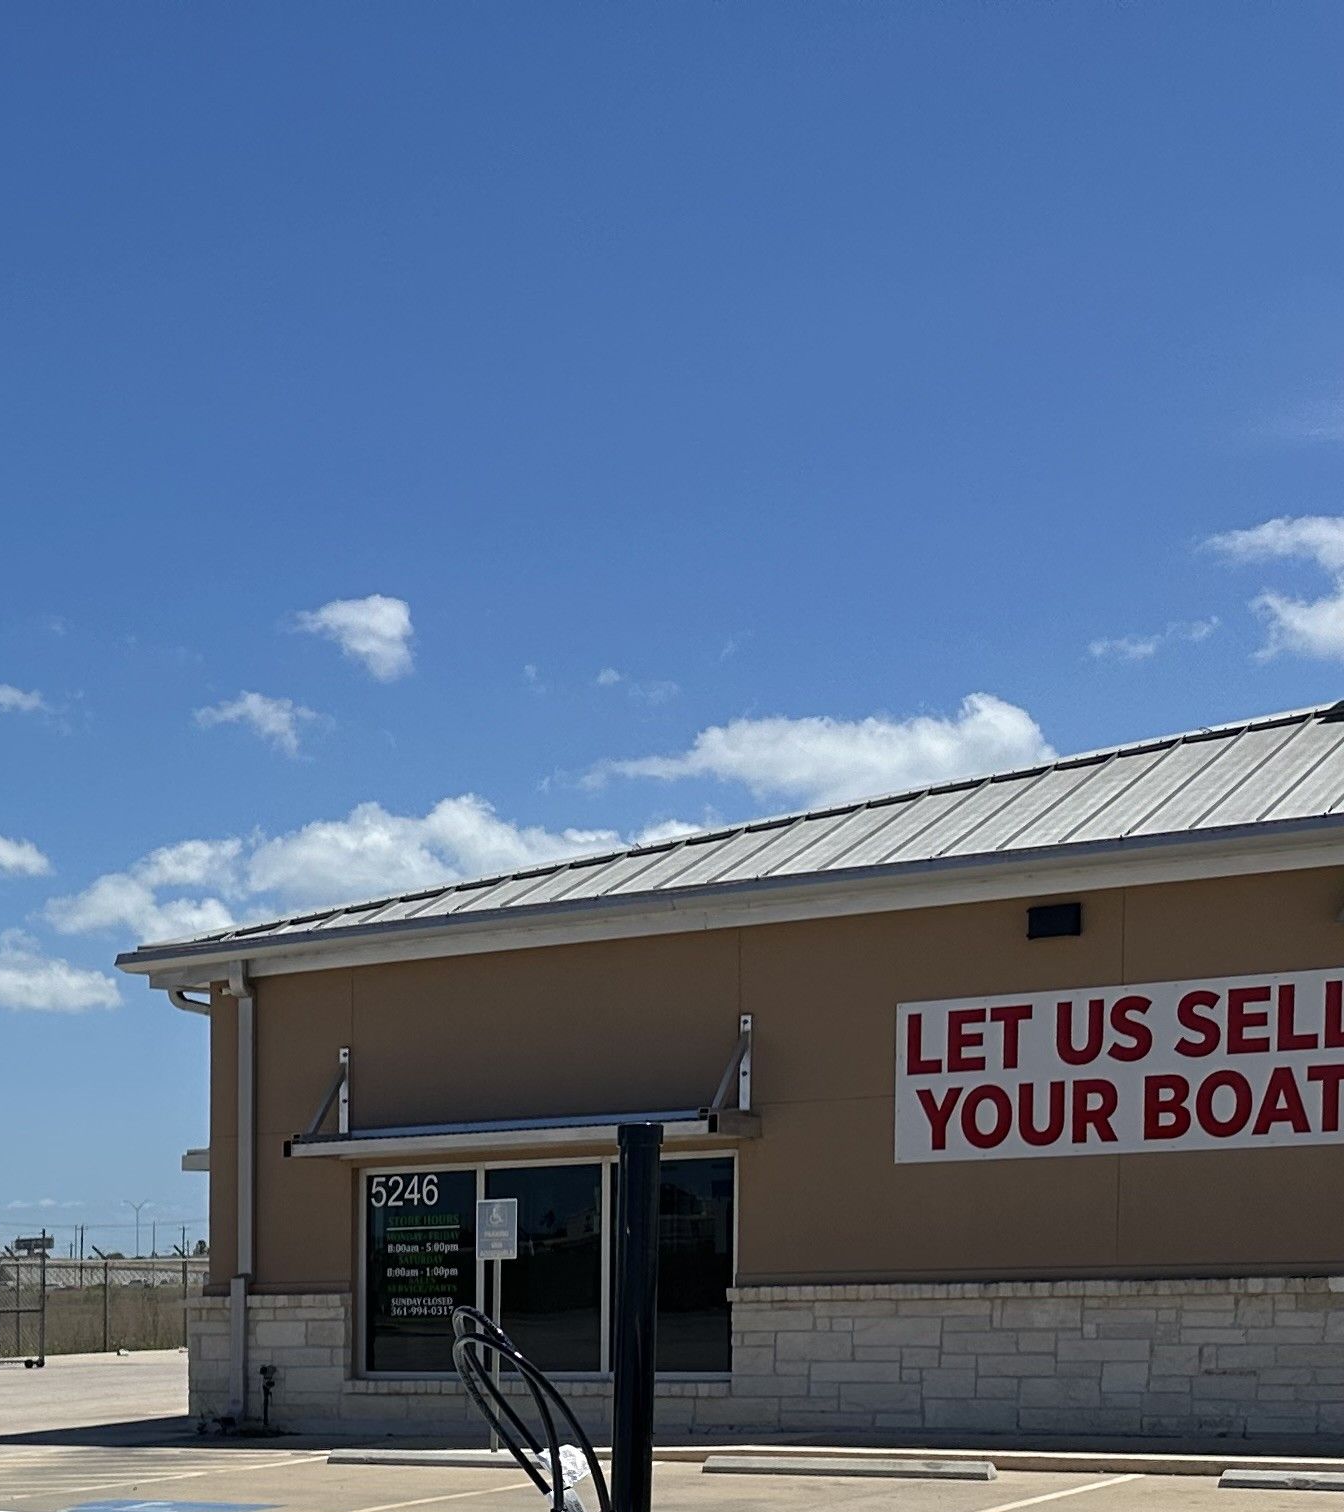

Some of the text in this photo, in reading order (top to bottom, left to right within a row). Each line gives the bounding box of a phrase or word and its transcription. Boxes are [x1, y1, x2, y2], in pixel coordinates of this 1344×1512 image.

[907, 1004, 1033, 1076] LET
[1056, 995, 1153, 1065] US
[916, 1064, 1344, 1151] YOUR BOAT
[370, 1174, 439, 1208] 5246
[389, 1213, 460, 1226] STORE HOURS
[391, 1296, 453, 1306] SUNDAY CLOSED
